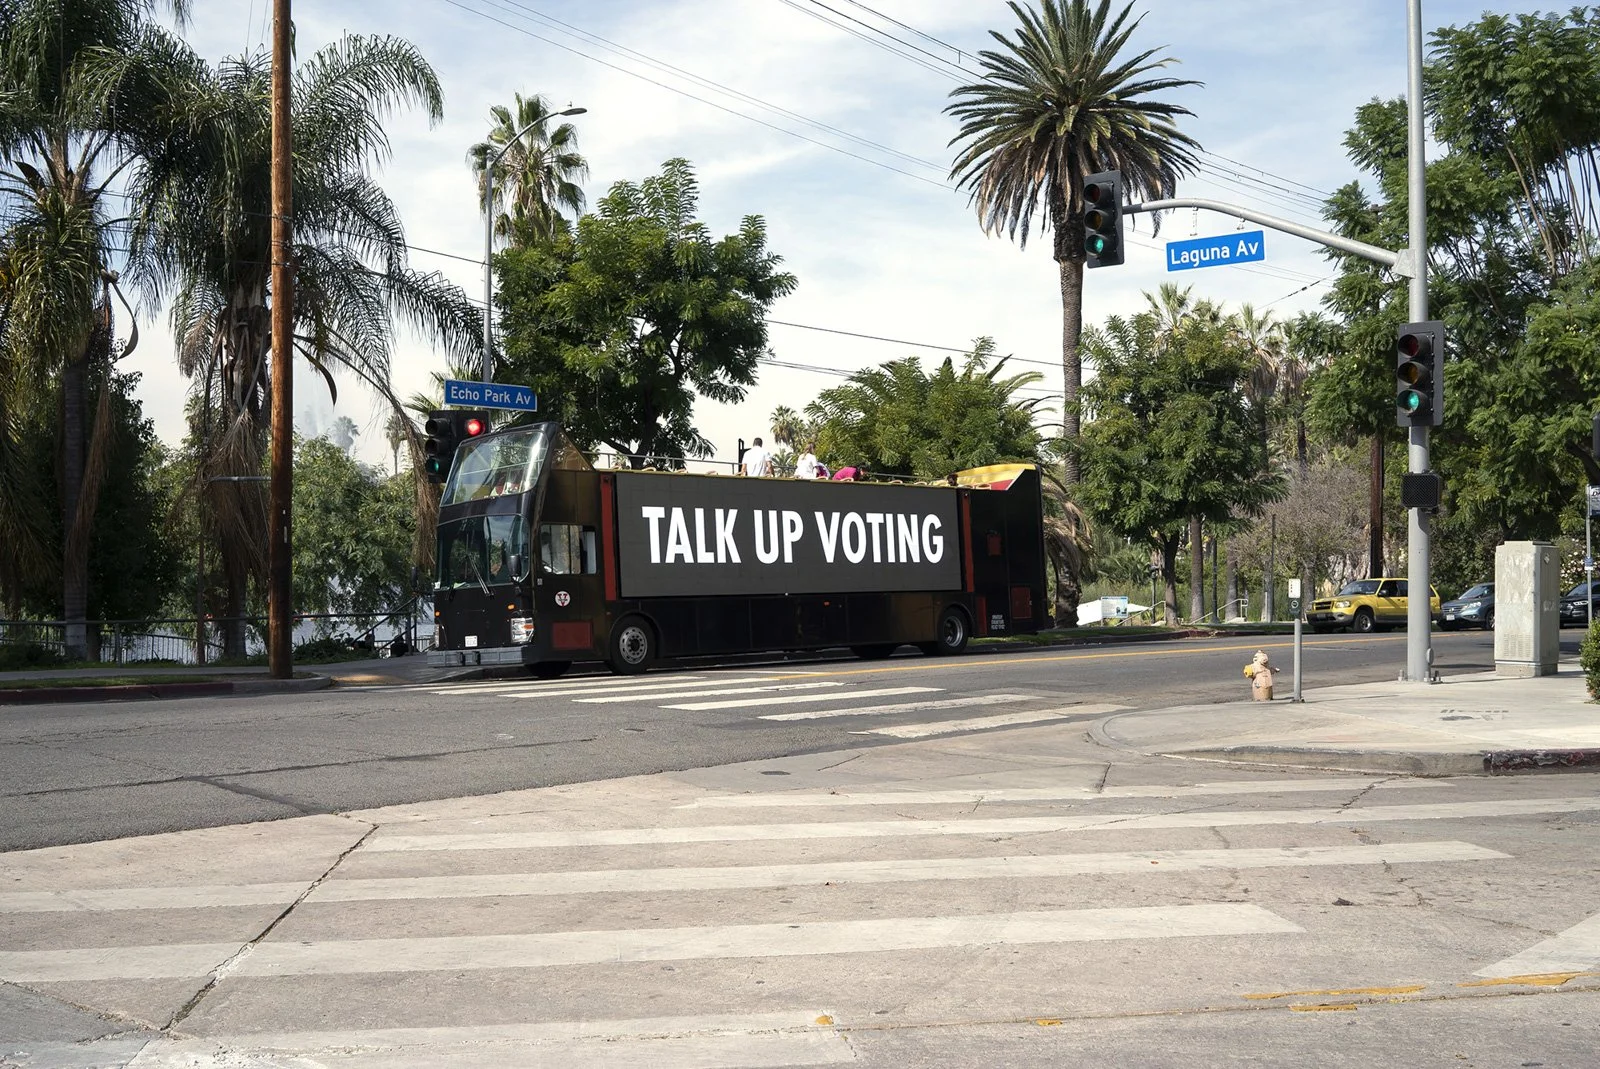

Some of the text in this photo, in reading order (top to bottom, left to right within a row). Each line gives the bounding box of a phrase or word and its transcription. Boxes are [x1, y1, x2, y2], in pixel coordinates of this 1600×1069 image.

[1170, 240, 1259, 267] Laguna Av
[451, 386, 531, 405] Echo Park Av
[641, 506, 944, 564] TALK UP VOTING
